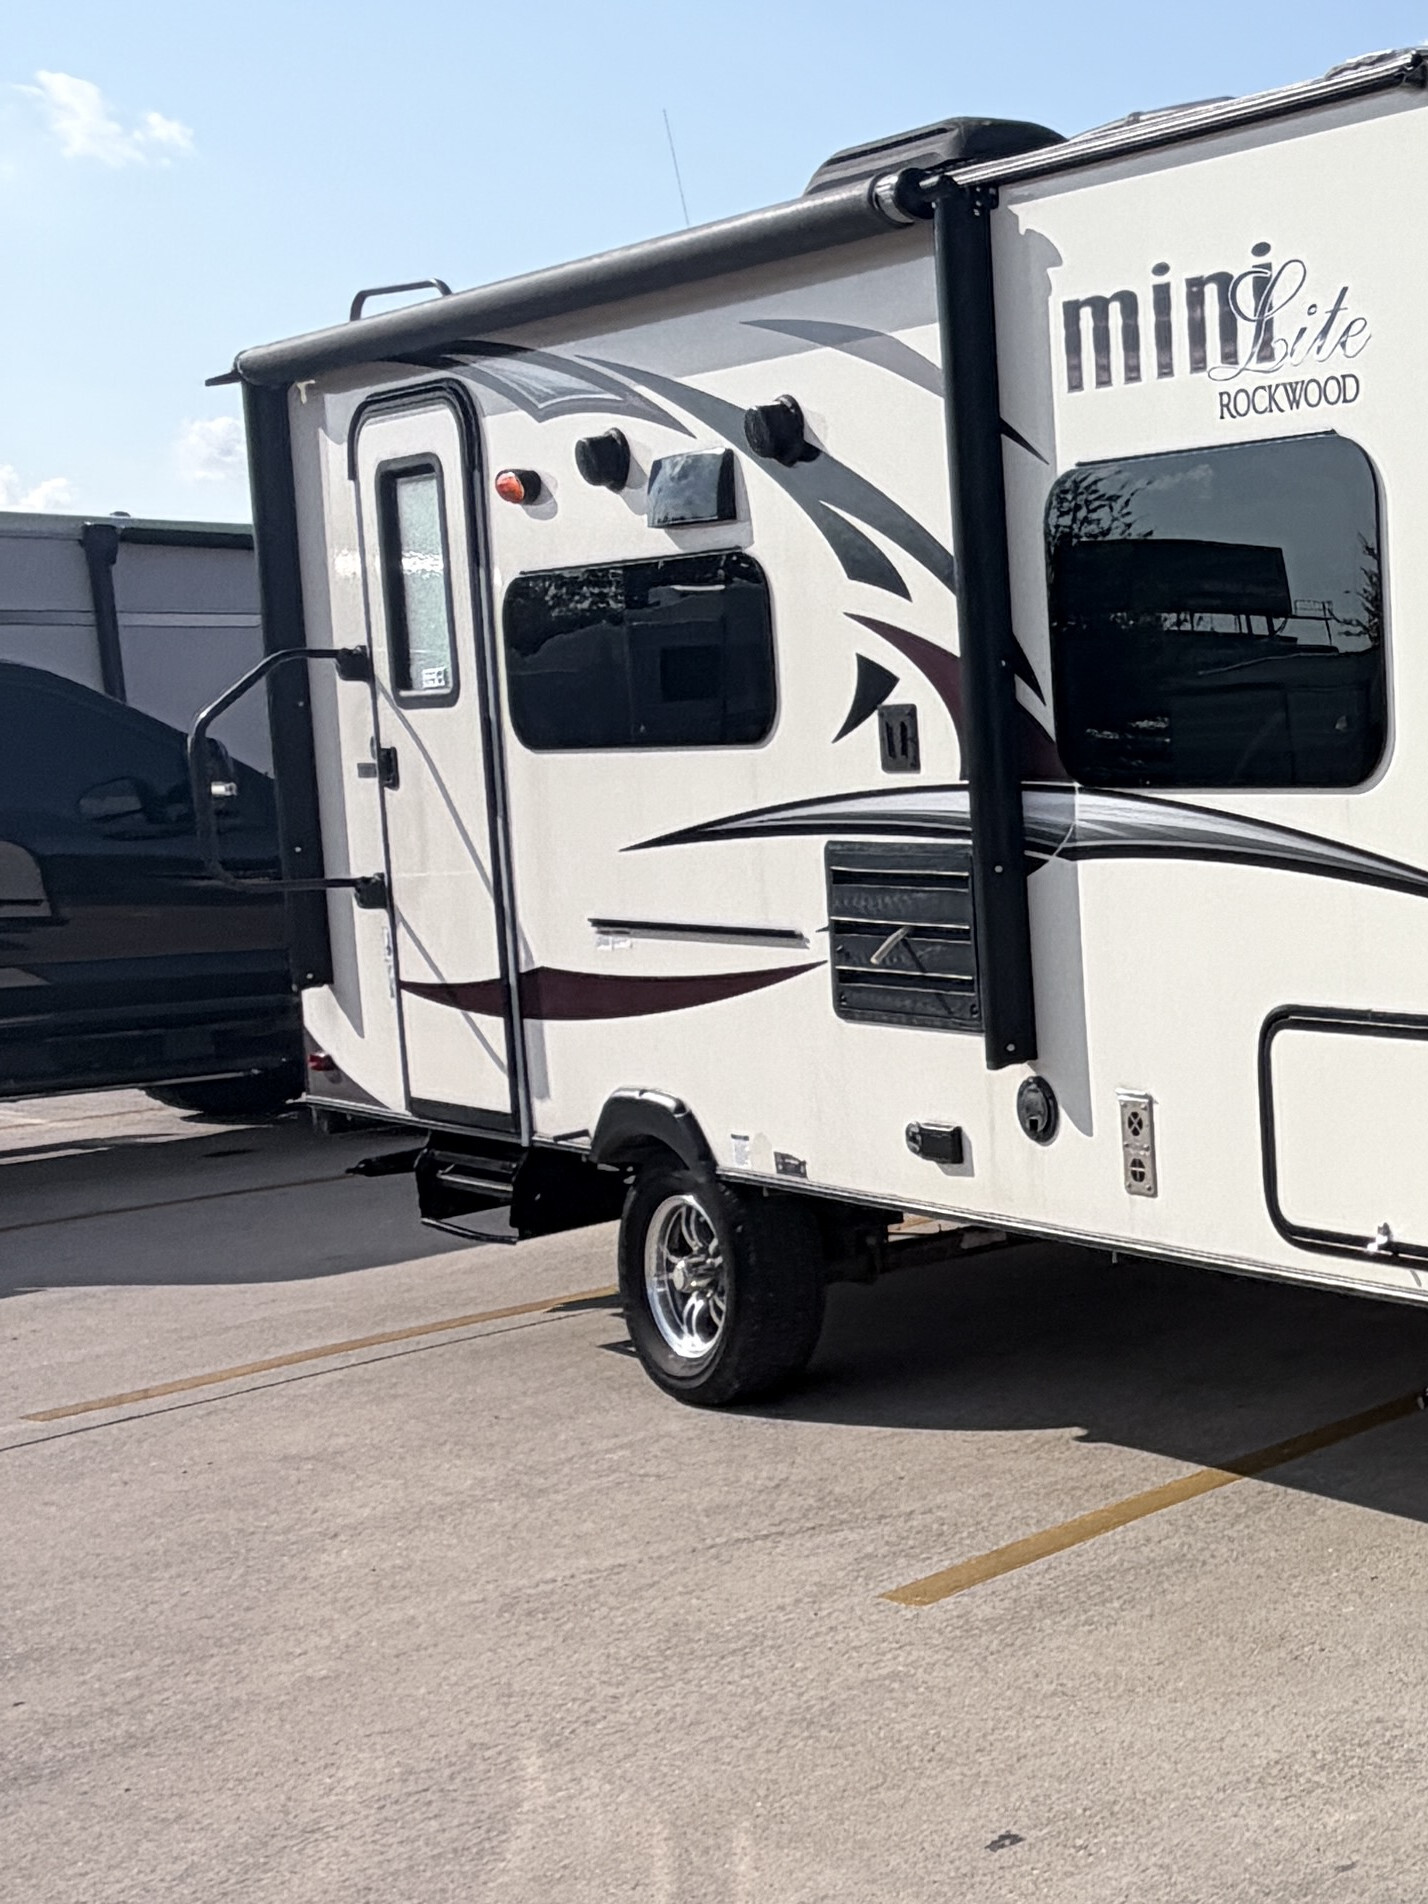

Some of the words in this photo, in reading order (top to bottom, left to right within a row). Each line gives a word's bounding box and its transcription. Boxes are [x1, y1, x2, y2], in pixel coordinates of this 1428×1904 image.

[1062, 241, 1276, 394] mini
[1207, 259, 1372, 382] Lite
[1218, 373, 1360, 420] ROCKWOOD
